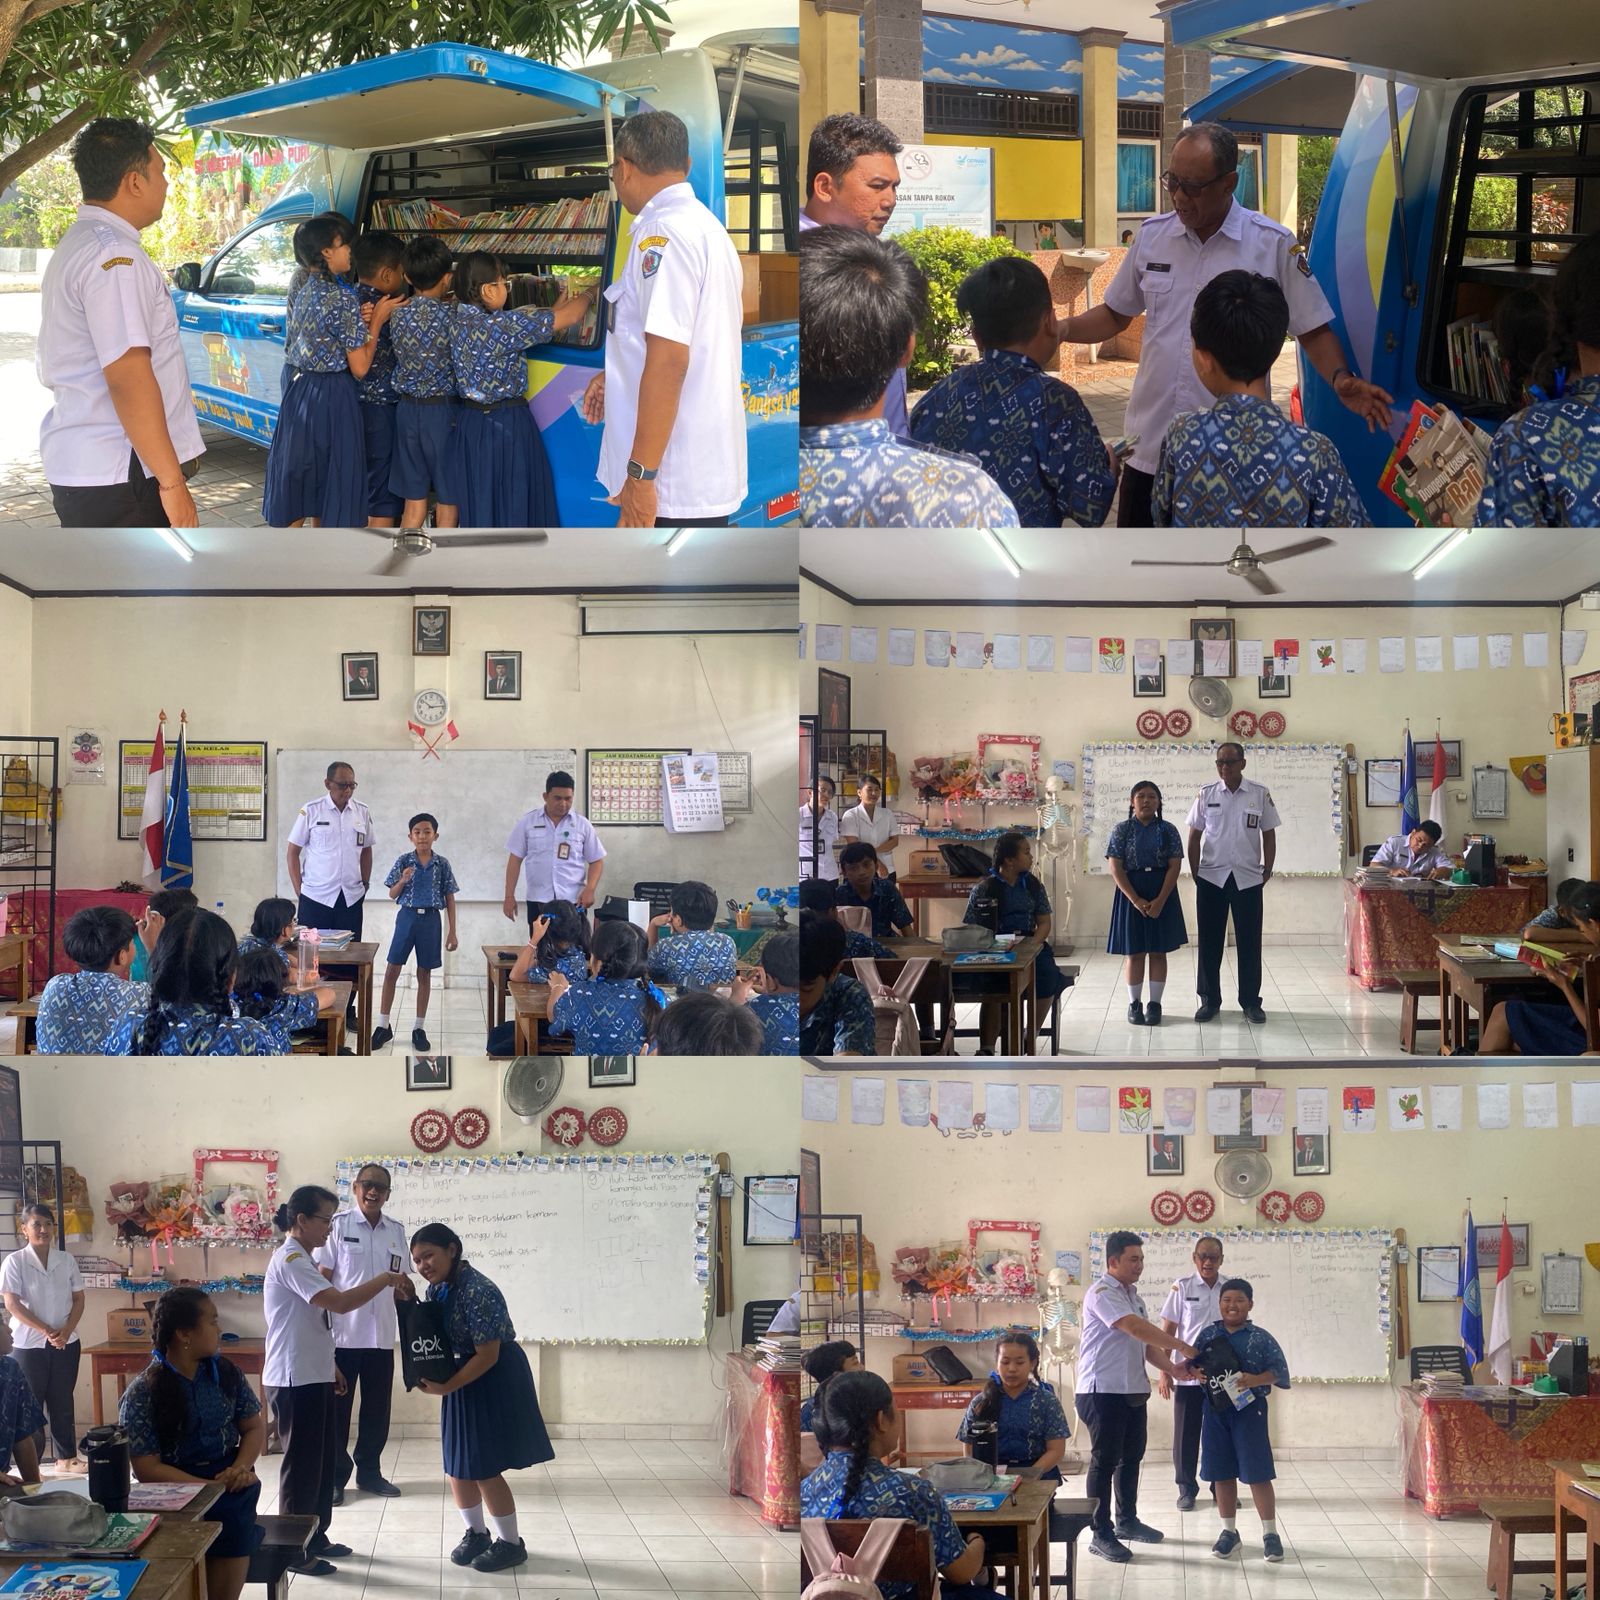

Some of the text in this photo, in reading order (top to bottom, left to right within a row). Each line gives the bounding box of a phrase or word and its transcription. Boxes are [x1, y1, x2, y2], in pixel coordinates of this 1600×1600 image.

[1418, 470, 1451, 502] Dongeng
[1445, 462, 1485, 515] Bali
[124, 1318, 146, 1327] AQUA
[411, 1334, 442, 1355] dpk
[906, 1361, 927, 1369] AQUA
